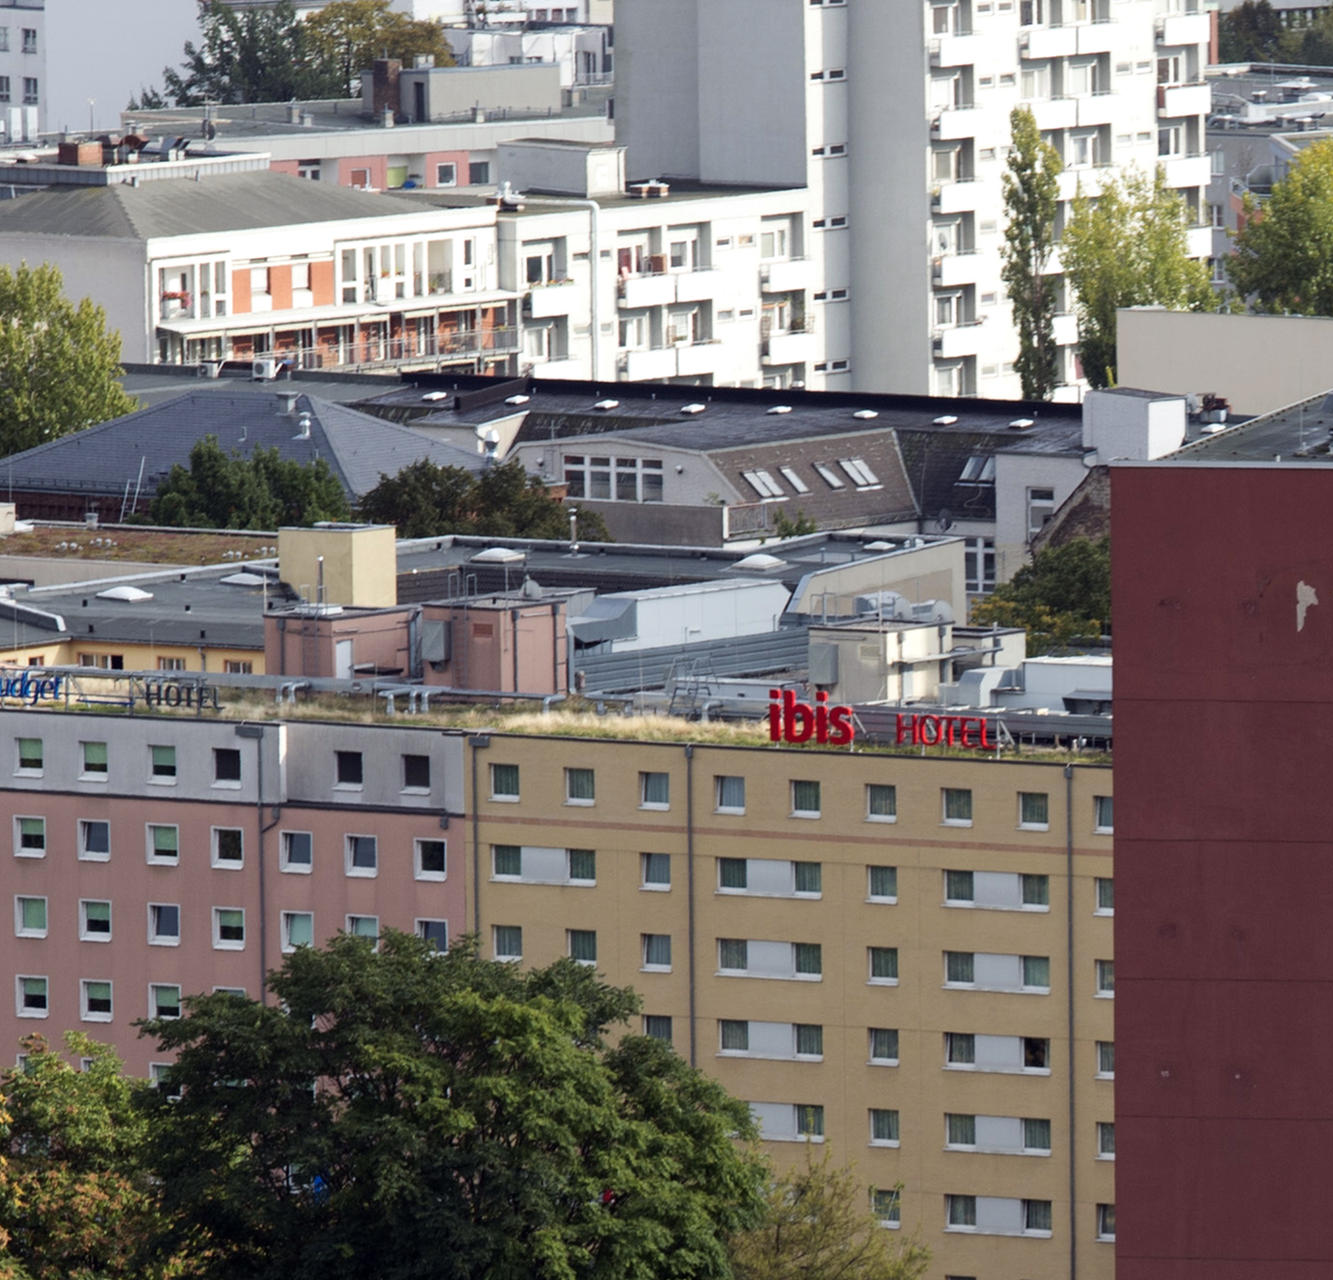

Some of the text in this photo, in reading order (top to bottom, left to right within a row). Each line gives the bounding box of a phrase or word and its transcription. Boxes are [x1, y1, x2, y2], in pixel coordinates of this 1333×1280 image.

[145, 681, 226, 710] HOTEL
[769, 688, 997, 749] ibis HOTEL
